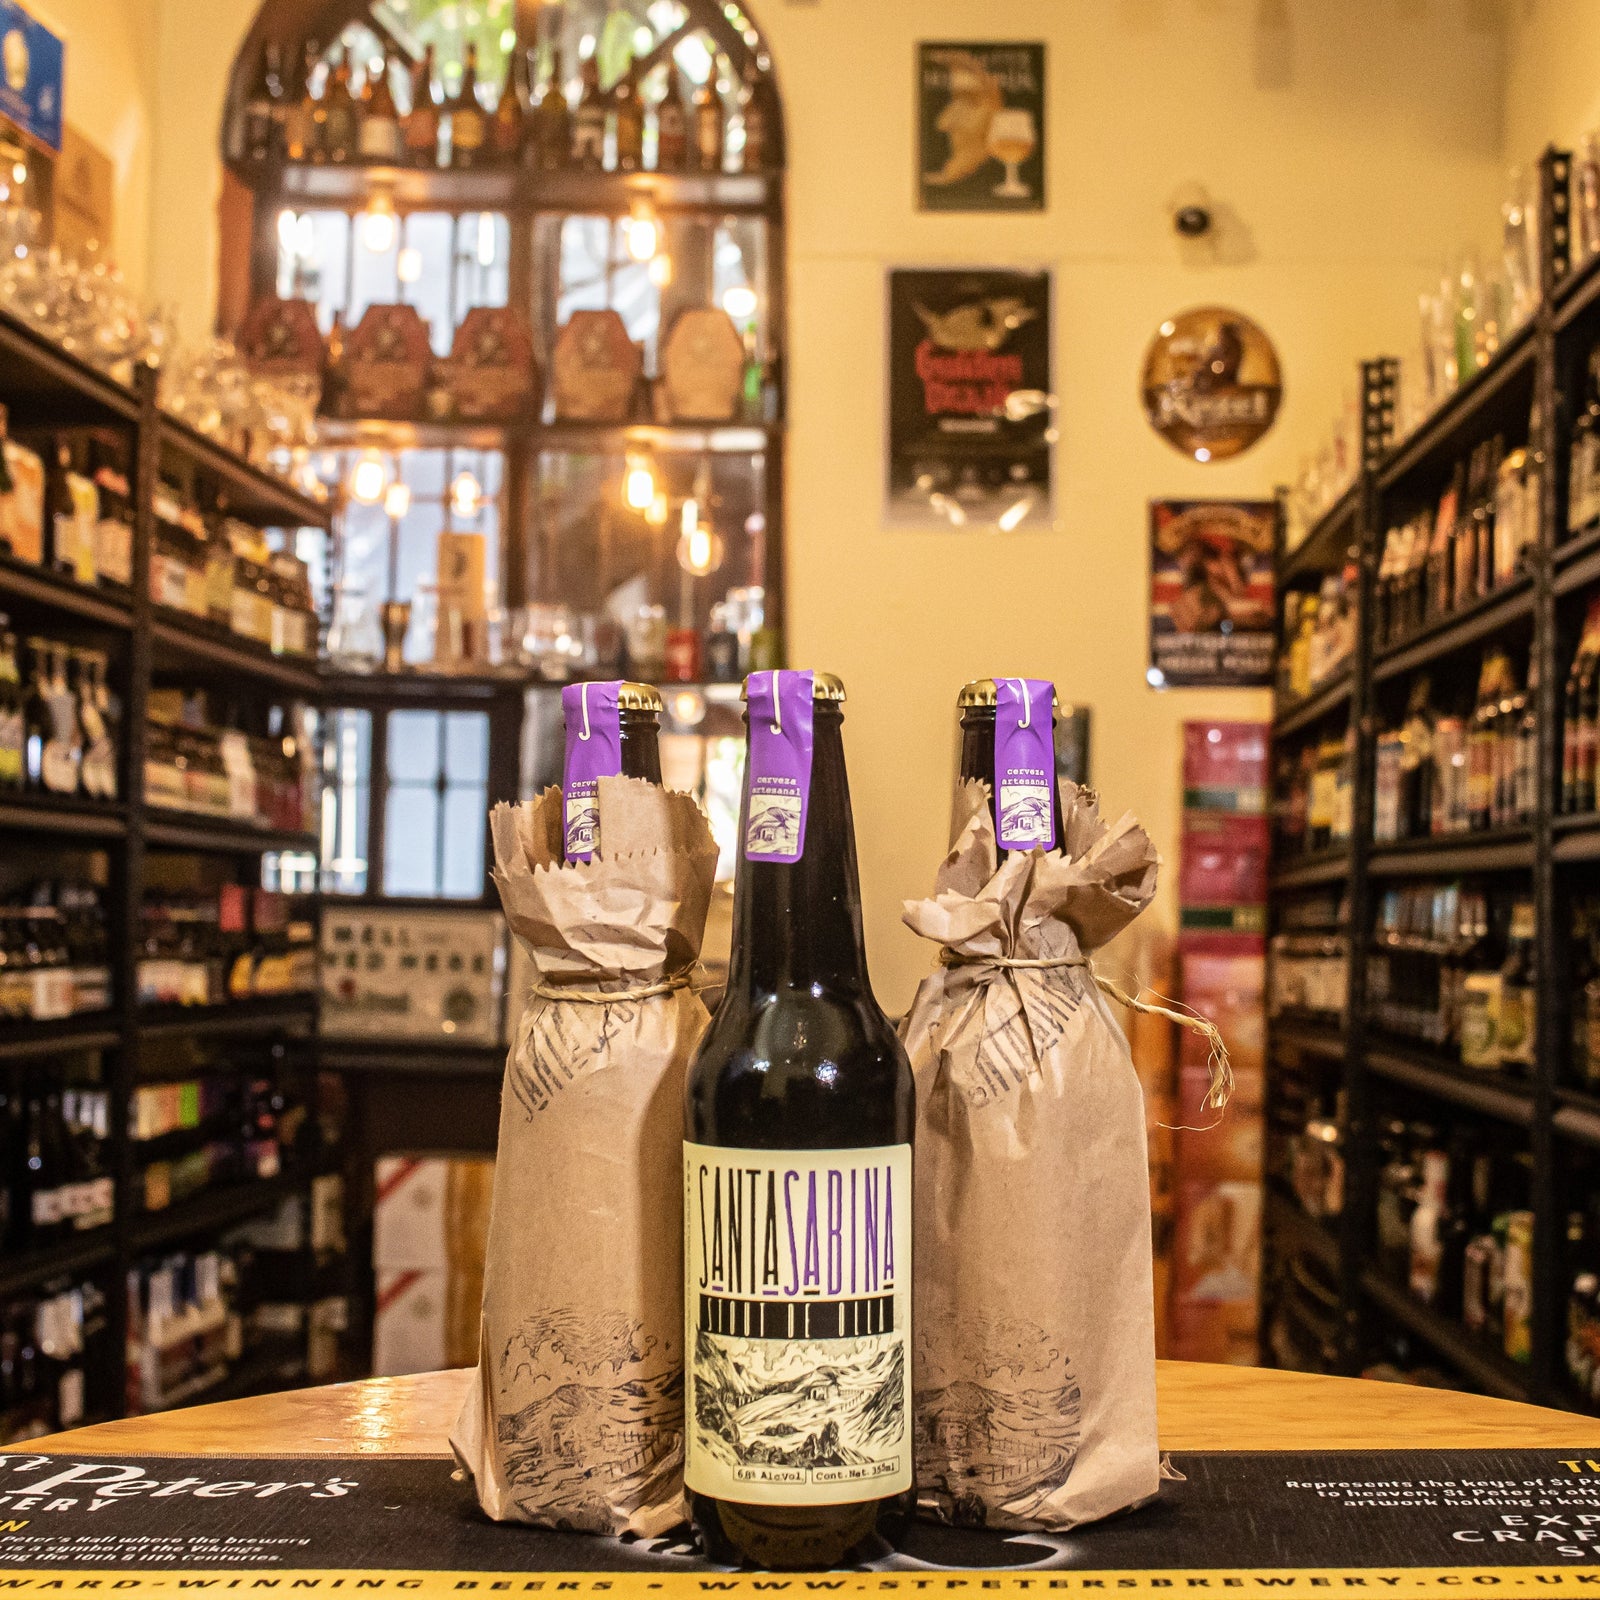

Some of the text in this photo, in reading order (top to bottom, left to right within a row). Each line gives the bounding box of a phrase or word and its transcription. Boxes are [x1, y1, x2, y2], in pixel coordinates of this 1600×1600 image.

[1007, 768, 1044, 776] cerveza
[571, 780, 597, 788] cerve
[757, 775, 796, 785] cerveza
[1002, 778, 1049, 786] artesanal
[567, 790, 599, 798] artesa
[752, 787, 801, 795] artesanal
[707, 1297, 765, 1337] STOUT
[5, 1463, 359, 1499] Peter's
[1285, 1480, 1412, 1489] Represents
[1461, 1479, 1516, 1488] keys
[1522, 1478, 1544, 1486] of
[1550, 1478, 1574, 1486] St
[1316, 1490, 1341, 1498] to
[1346, 1489, 1438, 1497] heaven.
[1442, 1489, 1467, 1497] St
[1343, 1498, 1439, 1507] artwork
[1443, 1498, 1534, 1507] holding
[0, 1536, 311, 1546] Peter's Hall where the brewery
[45, 1545, 122, 1554] symbol
[125, 1545, 150, 1553] of
[152, 1545, 185, 1553] the
[190, 1545, 264, 1555] Vikings
[34, 1553, 70, 1561] the
[453, 1580, 614, 1591] BEERS
